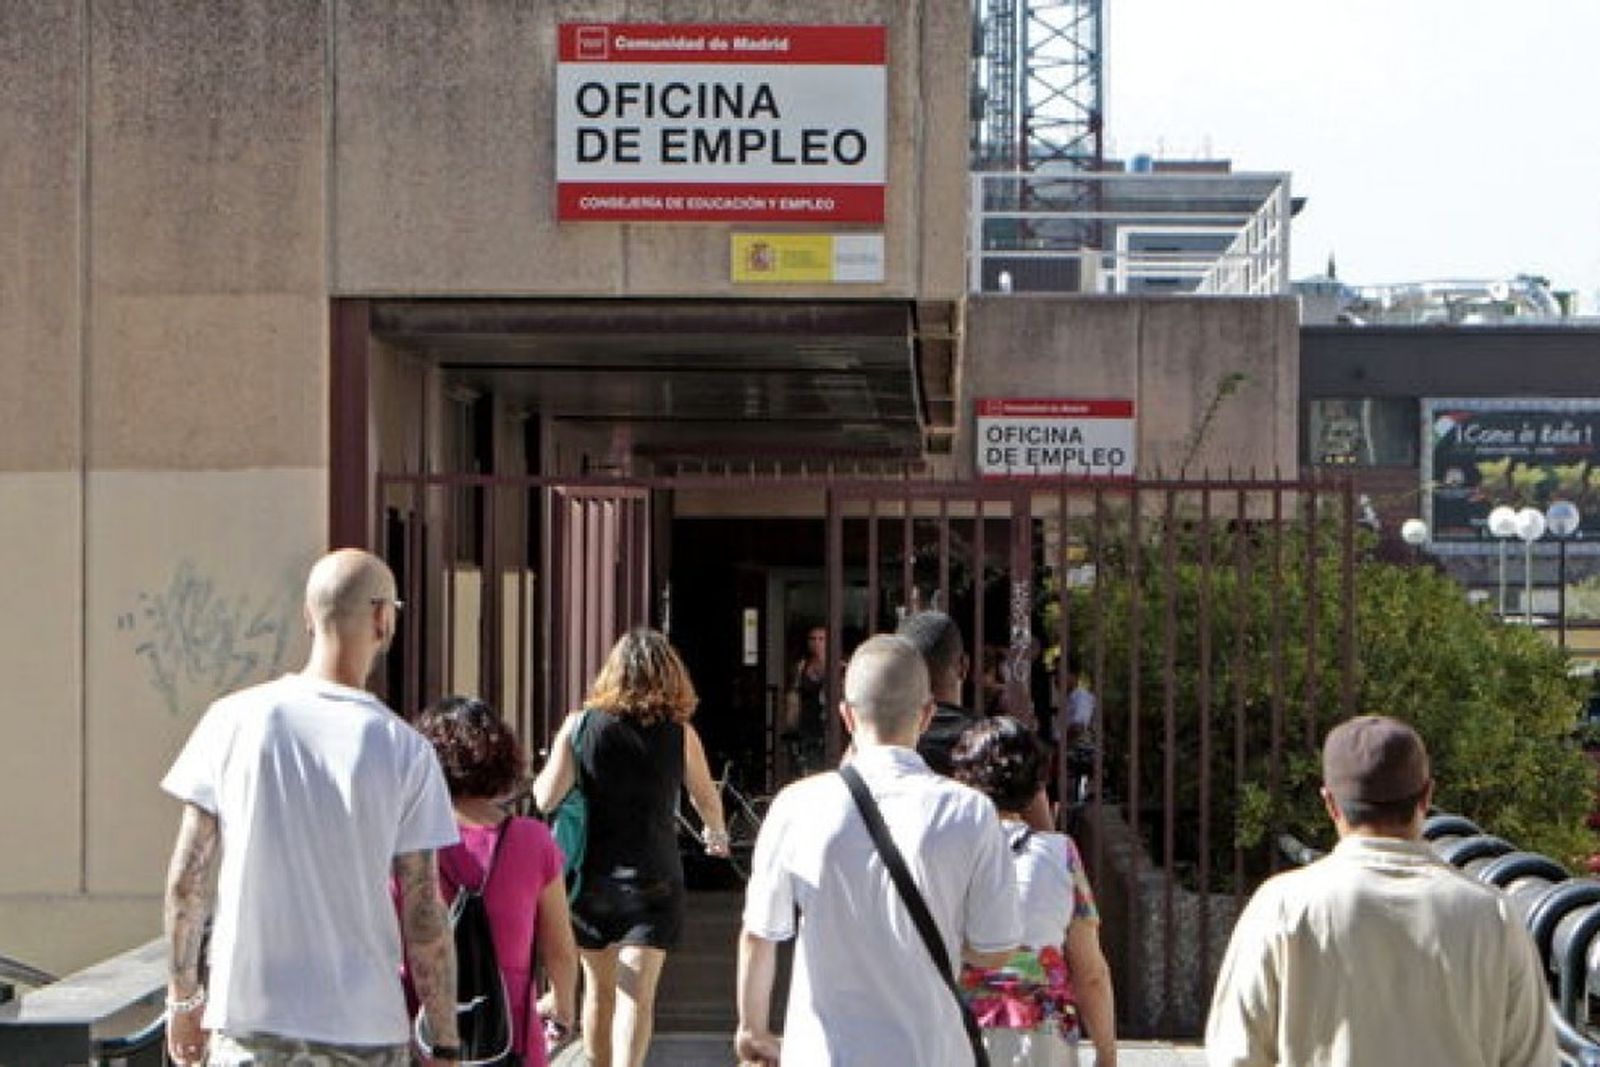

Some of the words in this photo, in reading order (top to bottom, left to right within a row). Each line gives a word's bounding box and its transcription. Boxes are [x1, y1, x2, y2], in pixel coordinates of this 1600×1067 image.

[615, 35, 705, 51] Comunidad
[708, 36, 729, 51] de
[733, 36, 788, 51] Madrid
[575, 81, 781, 119] OFICINA
[576, 128, 641, 163] DE
[660, 128, 868, 165] EMPLEO
[665, 197, 684, 210] DE
[780, 197, 836, 211] EMPLEO
[986, 425, 1082, 444] OFICINA
[986, 447, 1017, 467] DE
[1026, 447, 1126, 467] EMPLEO
